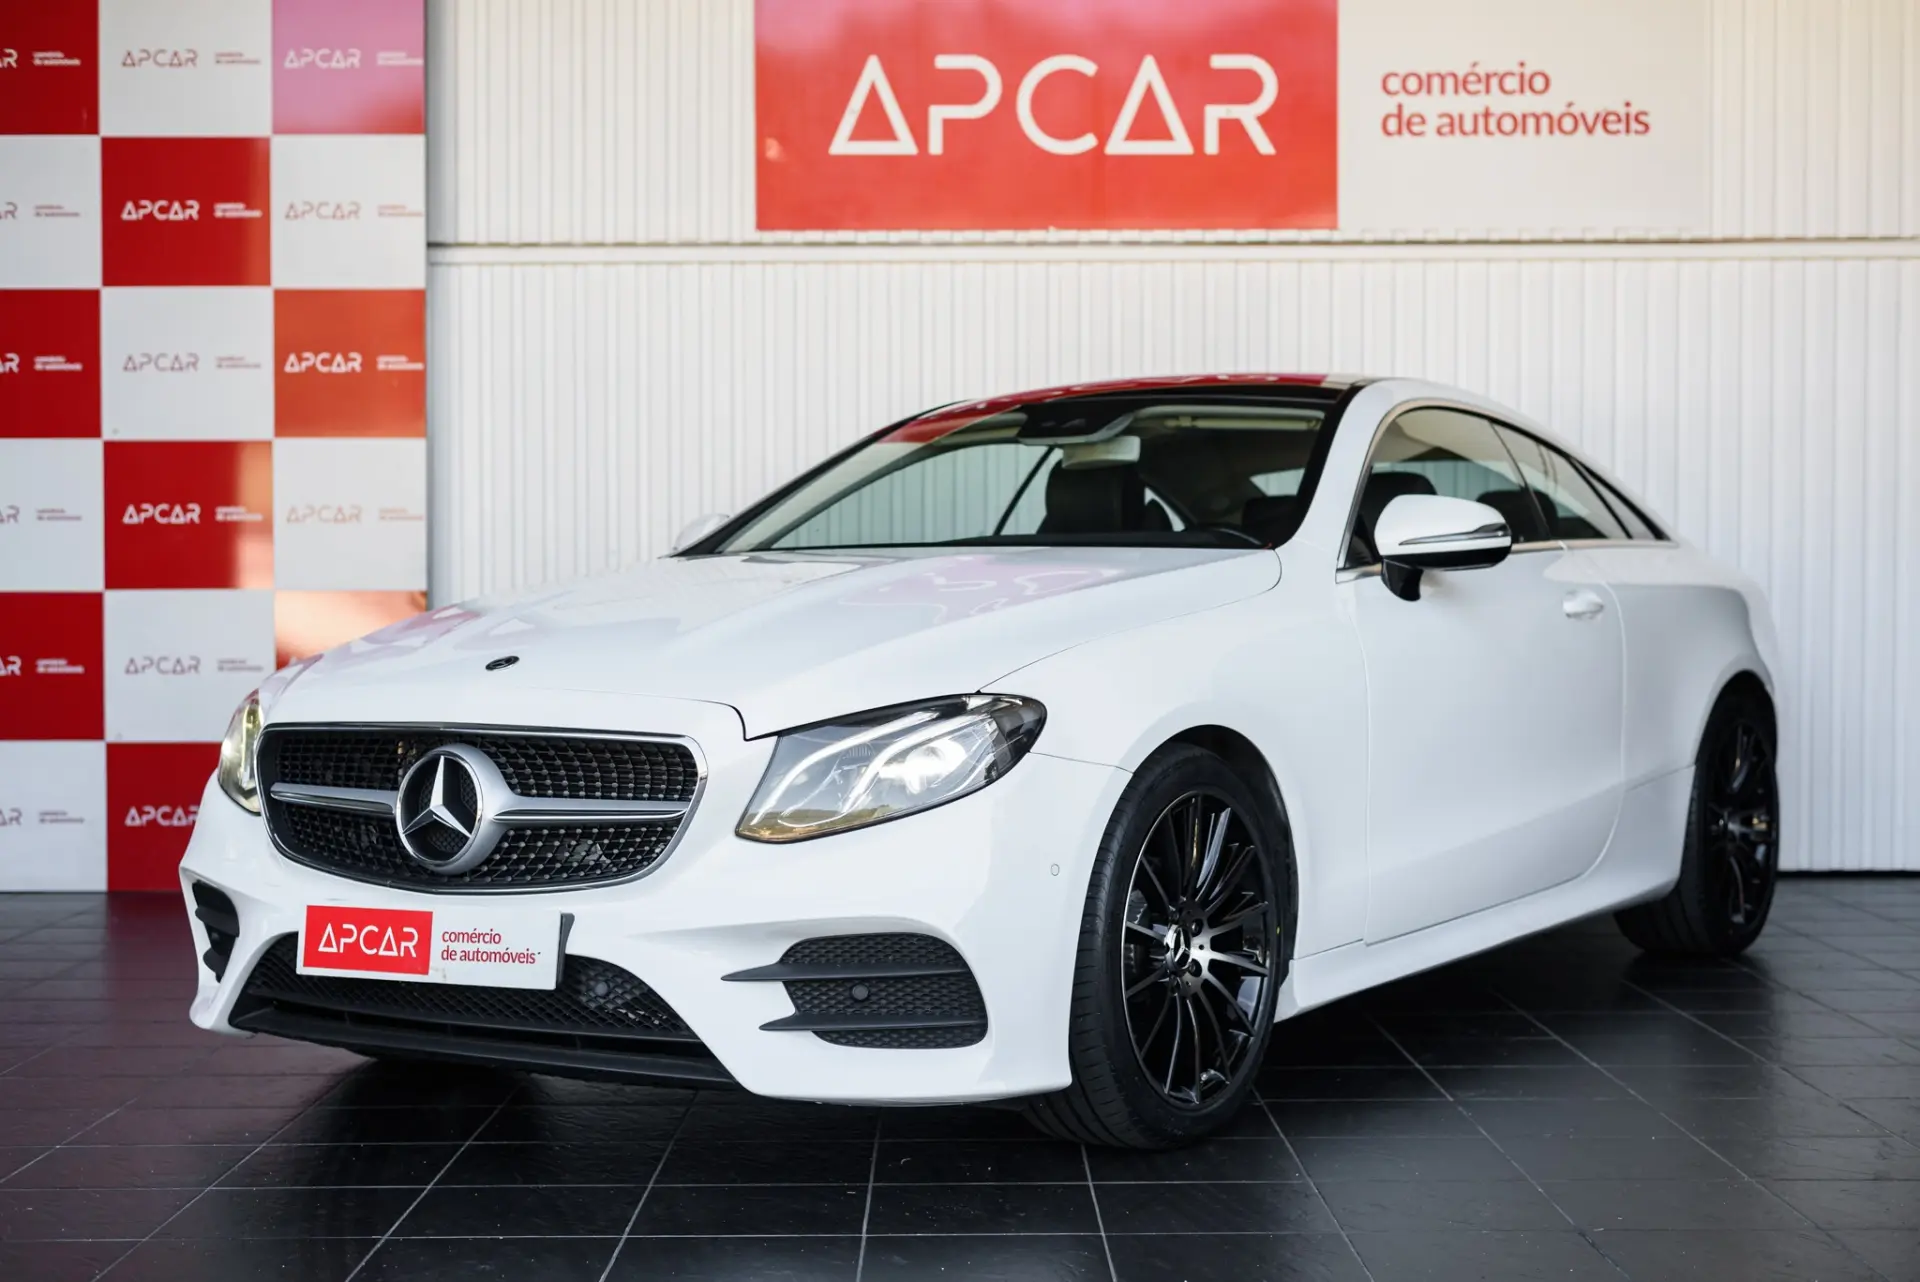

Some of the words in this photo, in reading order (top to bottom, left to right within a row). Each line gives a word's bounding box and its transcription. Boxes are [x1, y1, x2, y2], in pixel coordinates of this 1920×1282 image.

[121, 48, 198, 68] APCAR
[283, 48, 361, 69] APCAR
[1381, 61, 1551, 96] comércio
[829, 54, 1279, 156] APCAR
[1381, 103, 1427, 137] de
[1435, 102, 1651, 137] automóveis
[121, 200, 200, 220] APCAR
[284, 201, 361, 220] APCAR
[122, 353, 200, 373] APCAR
[284, 352, 362, 373] APCAR
[122, 503, 201, 524] APCAR
[286, 504, 362, 524] APCAR
[124, 656, 201, 675] APCAR
[318, 922, 419, 958] APCAR
[441, 928, 502, 944] comércio
[441, 945, 457, 961] de
[459, 947, 536, 964] automóveis
